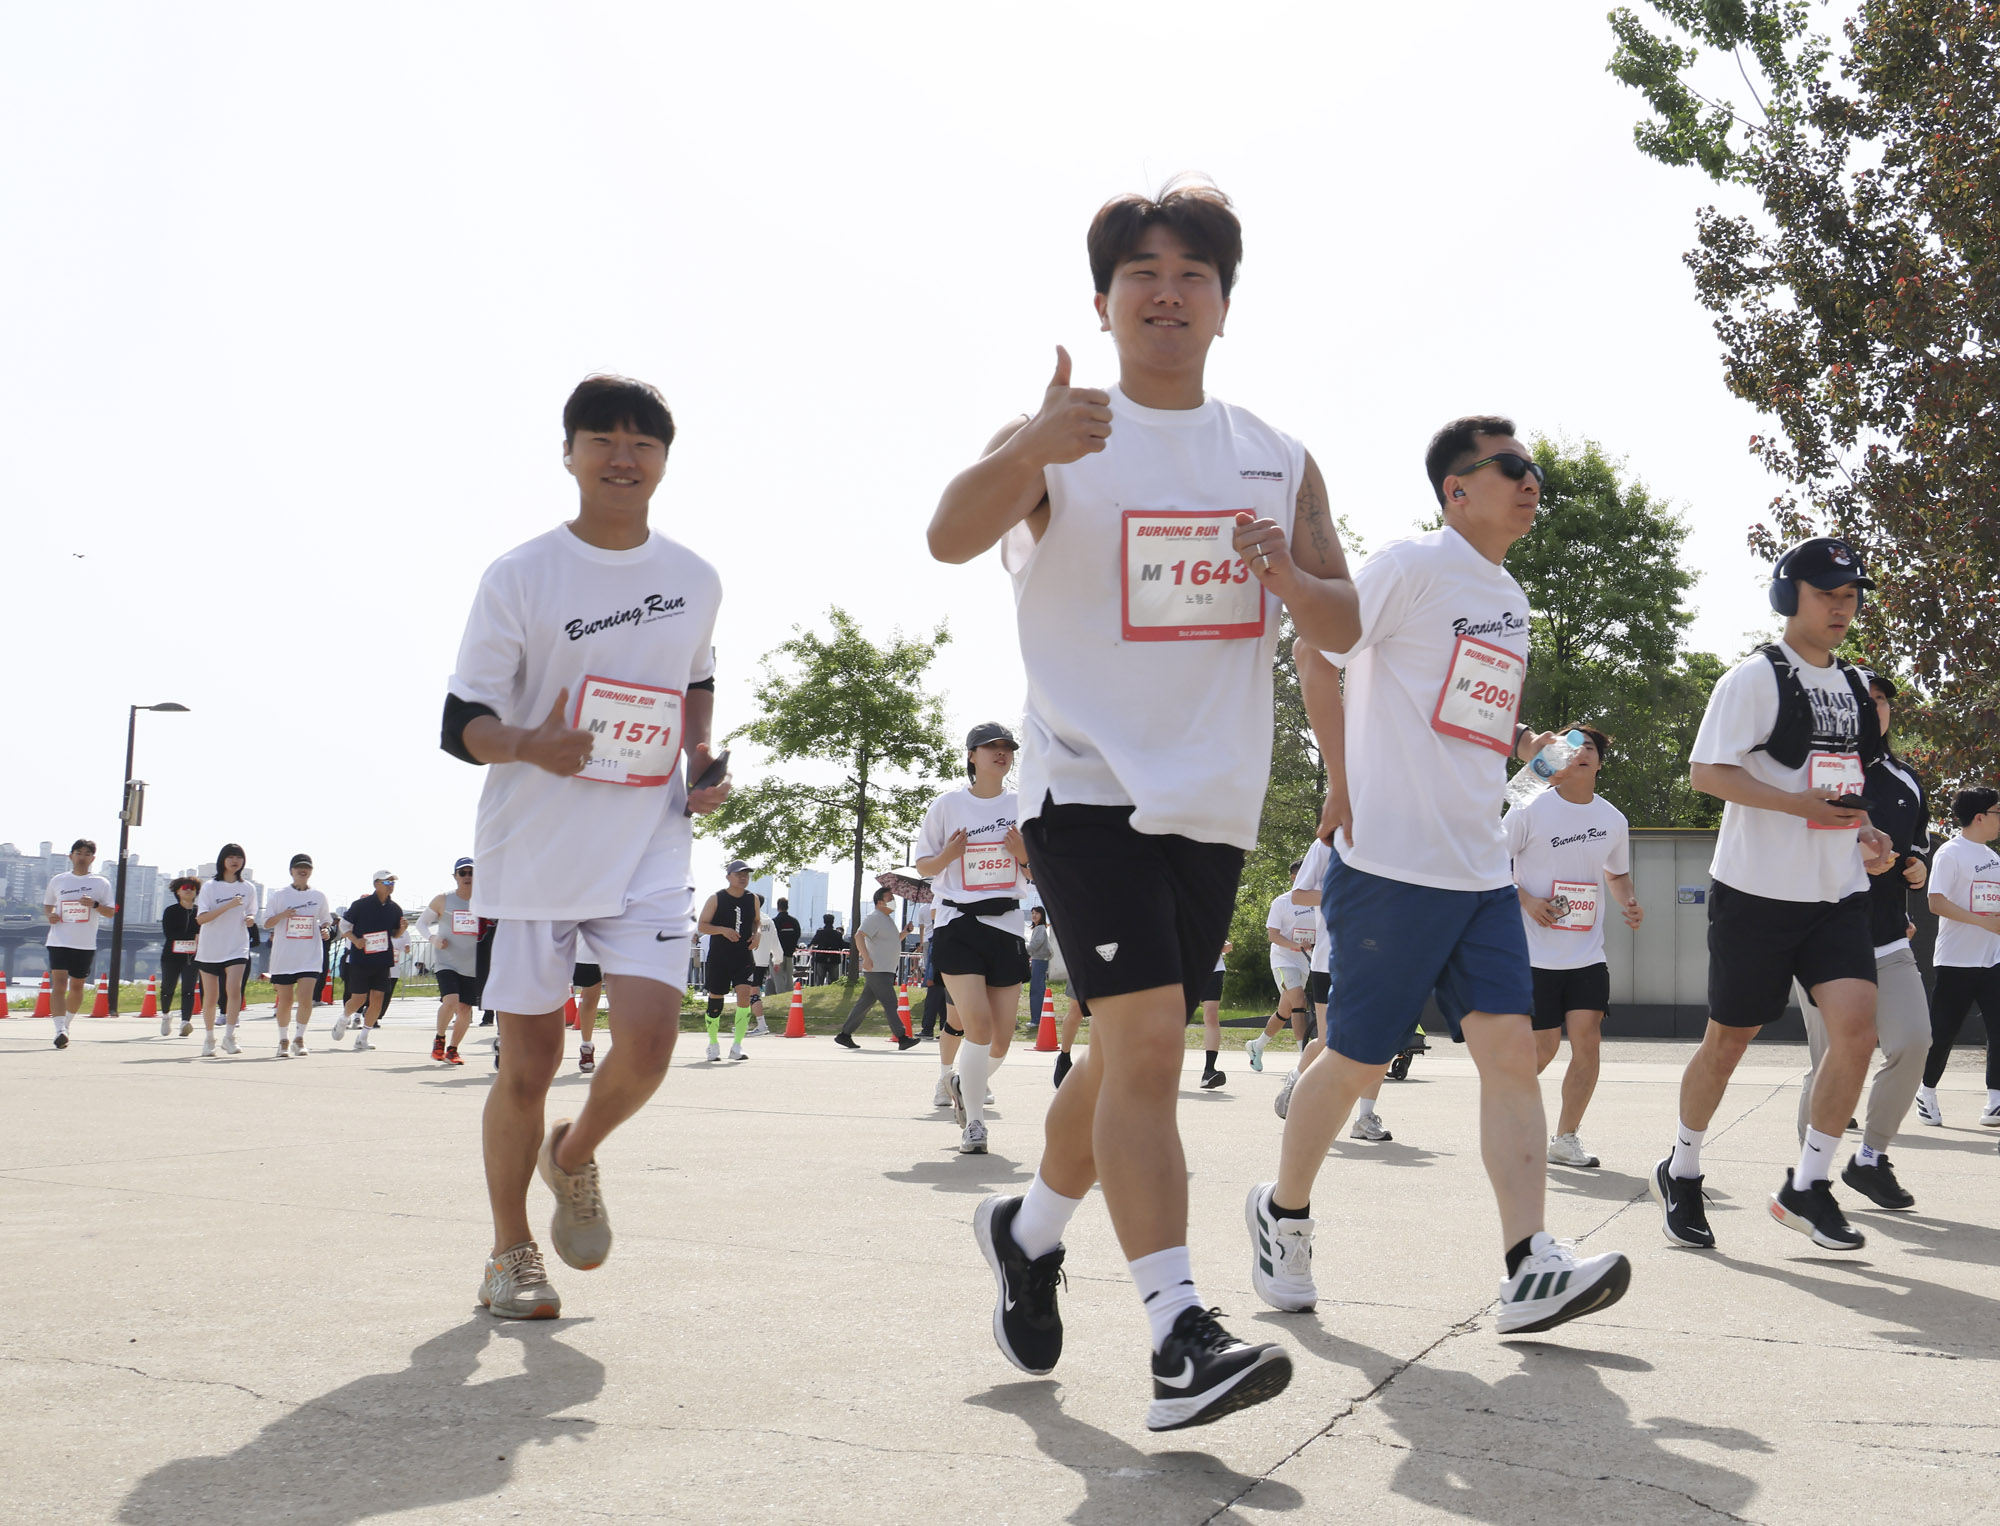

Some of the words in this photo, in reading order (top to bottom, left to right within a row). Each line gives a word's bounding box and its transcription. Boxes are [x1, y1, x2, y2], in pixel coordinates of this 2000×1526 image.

[1136, 525, 1193, 537] BURNING
[1194, 525, 1220, 537] RUN
[1141, 564, 1163, 581] M
[1170, 560, 1249, 585] 1643
[565, 607, 645, 641] Burning
[643, 594, 686, 617] Run
[1452, 617, 1504, 638] Burning
[1502, 611, 1525, 631] Run
[1464, 648, 1497, 666] BURNING
[1496, 659, 1512, 671] RUN
[592, 688, 638, 704] BURNING
[637, 696, 657, 706] RUN
[1456, 677, 1471, 692] M
[1470, 681, 1516, 712] 2092
[588, 718, 608, 734] M
[613, 720, 671, 747] 1571
[1817, 761, 1846, 769] BURNI
[965, 824, 996, 838] urning
[995, 817, 1017, 829] Run
[1550, 833, 1588, 848] Burning
[1587, 827, 1608, 840] Run
[978, 858, 1011, 870] 3652
[1569, 900, 1595, 911] 2080
